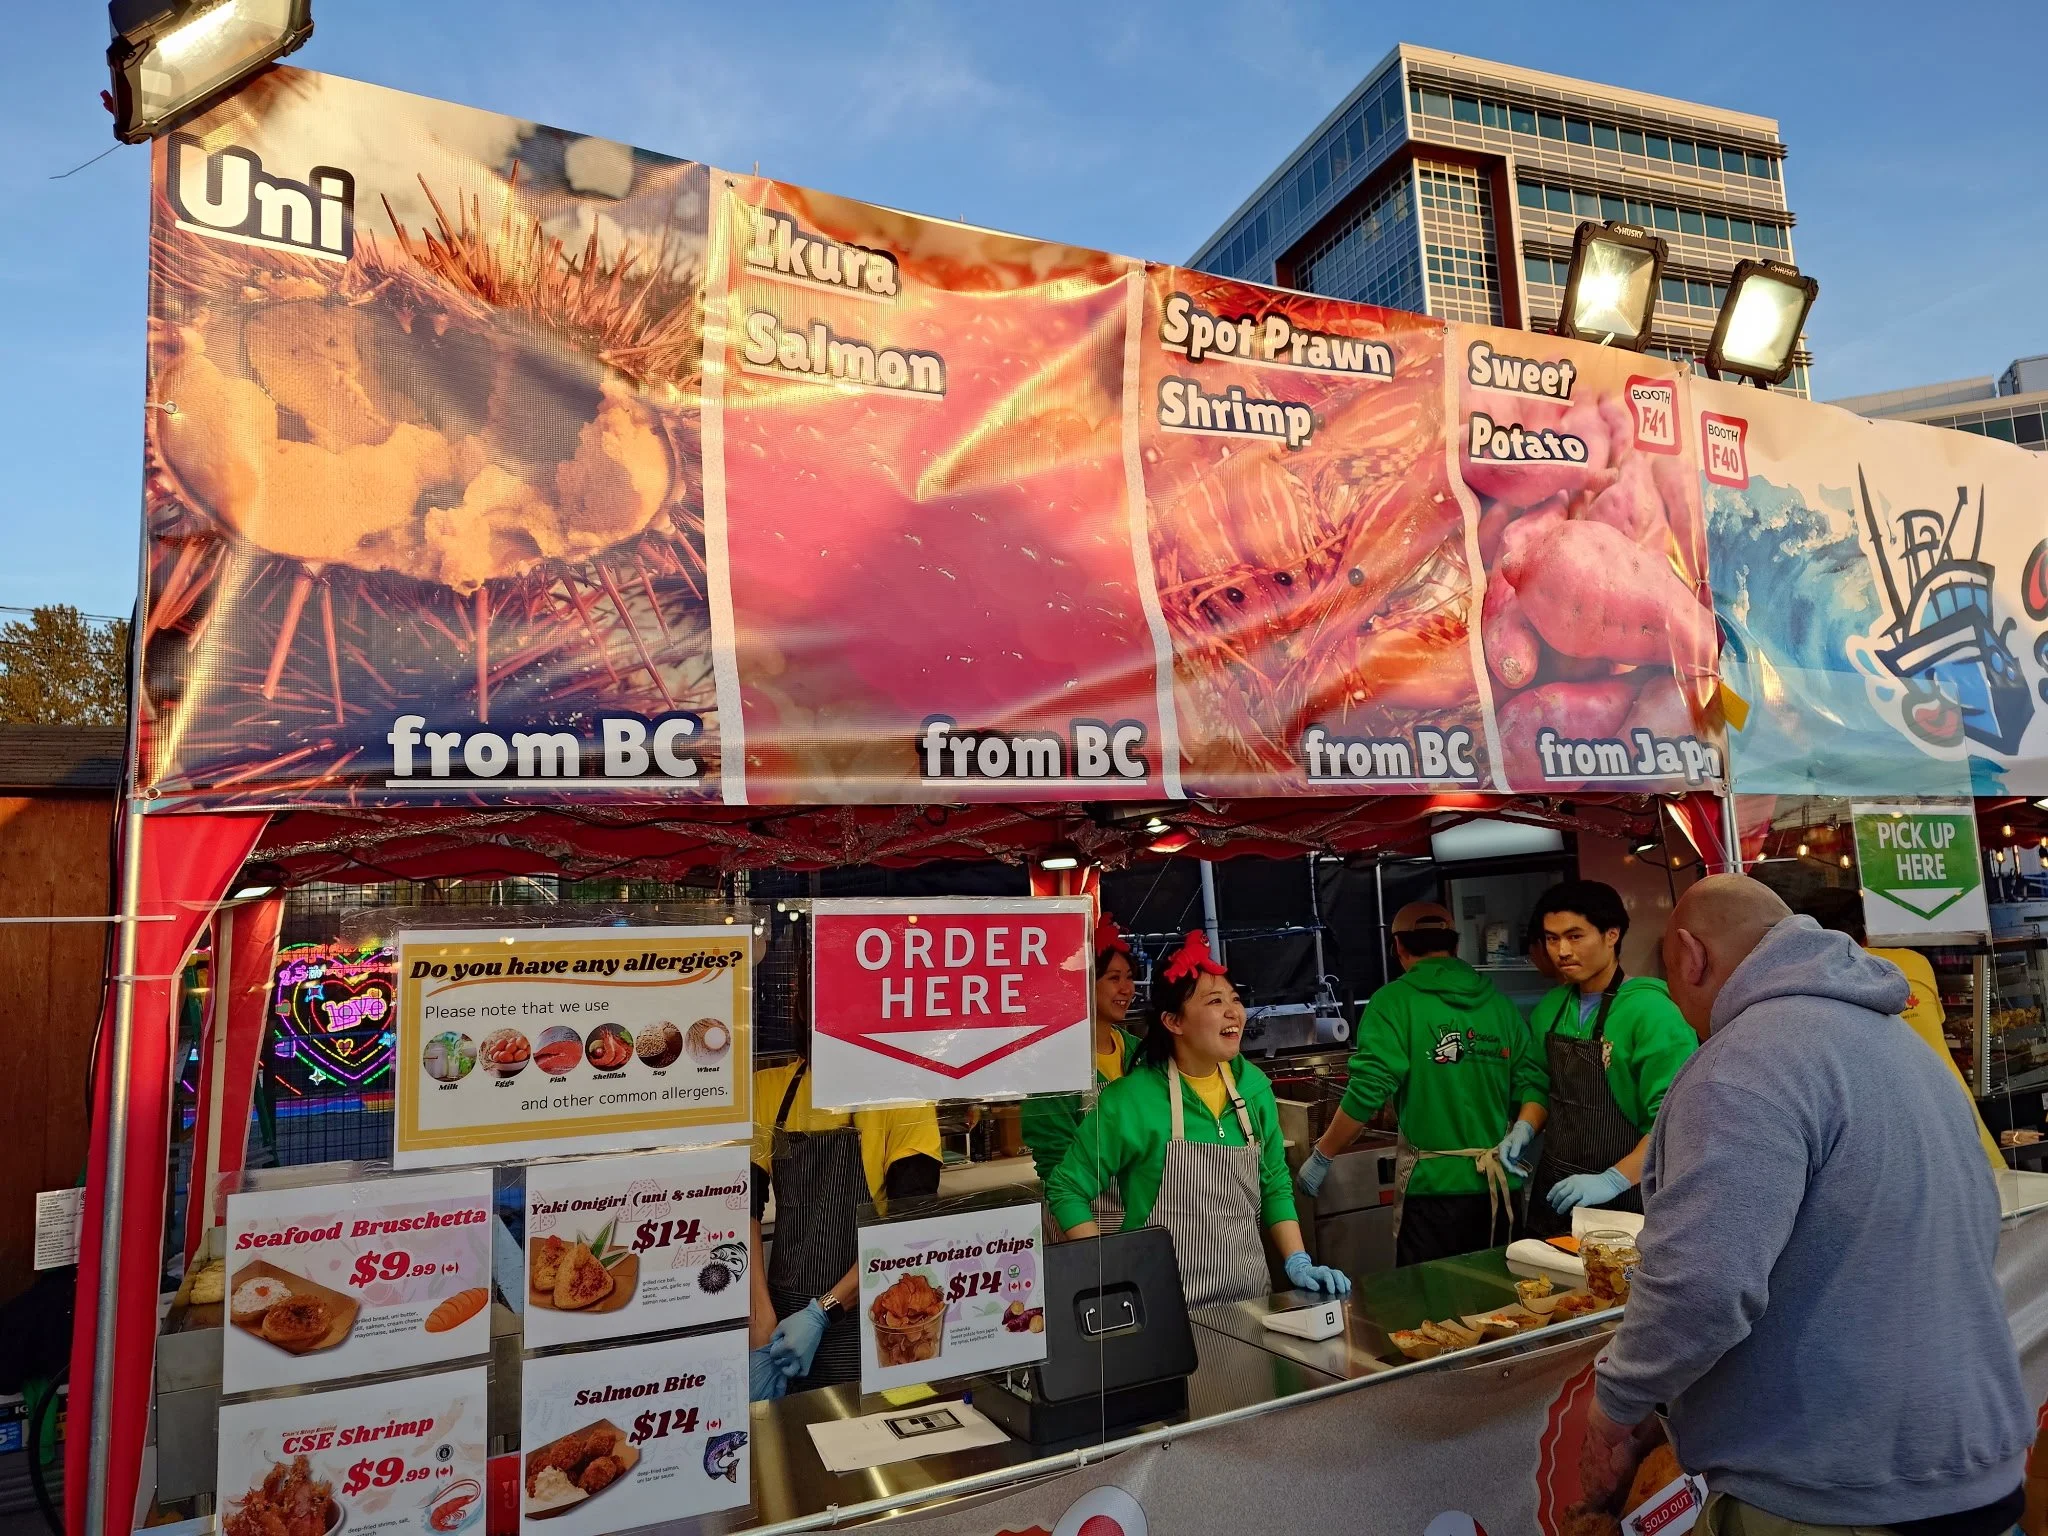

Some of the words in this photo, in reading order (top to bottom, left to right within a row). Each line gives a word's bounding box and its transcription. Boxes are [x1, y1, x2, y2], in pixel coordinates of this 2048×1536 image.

[176, 138, 345, 253] Uni
[1621, 226, 1644, 239] HUSKY
[747, 212, 898, 296] Ikura
[744, 311, 942, 392] Salmon
[1163, 297, 1254, 358] Spot
[1264, 314, 1392, 375] Prawn
[1470, 344, 1574, 398] Sweet
[1160, 380, 1312, 446] Shrimp
[1632, 389, 1671, 404] BOOTH
[1471, 415, 1585, 461] Potato
[1642, 406, 1668, 439] F41
[1708, 423, 1740, 443] BOOTH
[1711, 443, 1740, 474] F40
[387, 715, 581, 778] from
[602, 718, 699, 778] BC
[922, 721, 1063, 778] from
[1076, 724, 1147, 778] BC
[1305, 730, 1411, 777] from
[1417, 731, 1475, 778] BC
[1540, 732, 1623, 775] from
[1876, 822, 1928, 849] PICK
[1929, 822, 1956, 849] UP
[1895, 853, 1947, 881] HERE
[410, 959, 448, 979] Do
[448, 959, 502, 982] you
[506, 956, 568, 977] have
[572, 957, 621, 976] any
[623, 950, 744, 974] allergies?
[855, 926, 1049, 971] ORDER
[425, 1005, 476, 1019] Please
[481, 1003, 517, 1016] note
[521, 1001, 554, 1015] that
[559, 1001, 580, 1013] we
[585, 1000, 610, 1012] use
[881, 973, 1027, 1019] HERE
[438, 1083, 458, 1091] Milk
[494, 1079, 515, 1089] Eggs
[549, 1075, 567, 1084] Fish
[592, 1071, 627, 1081] Shellfish
[652, 1069, 667, 1078] Soy
[696, 1065, 720, 1074] Wheat
[521, 1096, 549, 1111] and
[552, 1093, 595, 1108] other
[598, 1089, 657, 1105] common
[661, 1085, 729, 1102] allergens.
[531, 1200, 569, 1216] Yaki
[571, 1194, 628, 1212] Onigiri
[671, 1190, 685, 1201] &
[686, 1180, 748, 1199] salmon)
[234, 1222, 344, 1250] Seafood
[349, 1209, 487, 1238] Bruschetta
[631, 1219, 701, 1253] $14
[349, 1250, 437, 1288] $9.99
[868, 1253, 924, 1275] Sweet
[925, 1244, 983, 1266] Potato
[985, 1236, 1035, 1255] Chips
[946, 1270, 1003, 1304] $14
[573, 1382, 659, 1406] Salmon
[662, 1373, 706, 1394] Bite
[282, 1431, 335, 1455] CSE
[336, 1417, 435, 1448] Shrimp
[629, 1407, 700, 1446] $14
[342, 1457, 431, 1498] $9.99
[1644, 1509, 1670, 1533] SOLD
[1670, 1493, 1690, 1513] OUT
